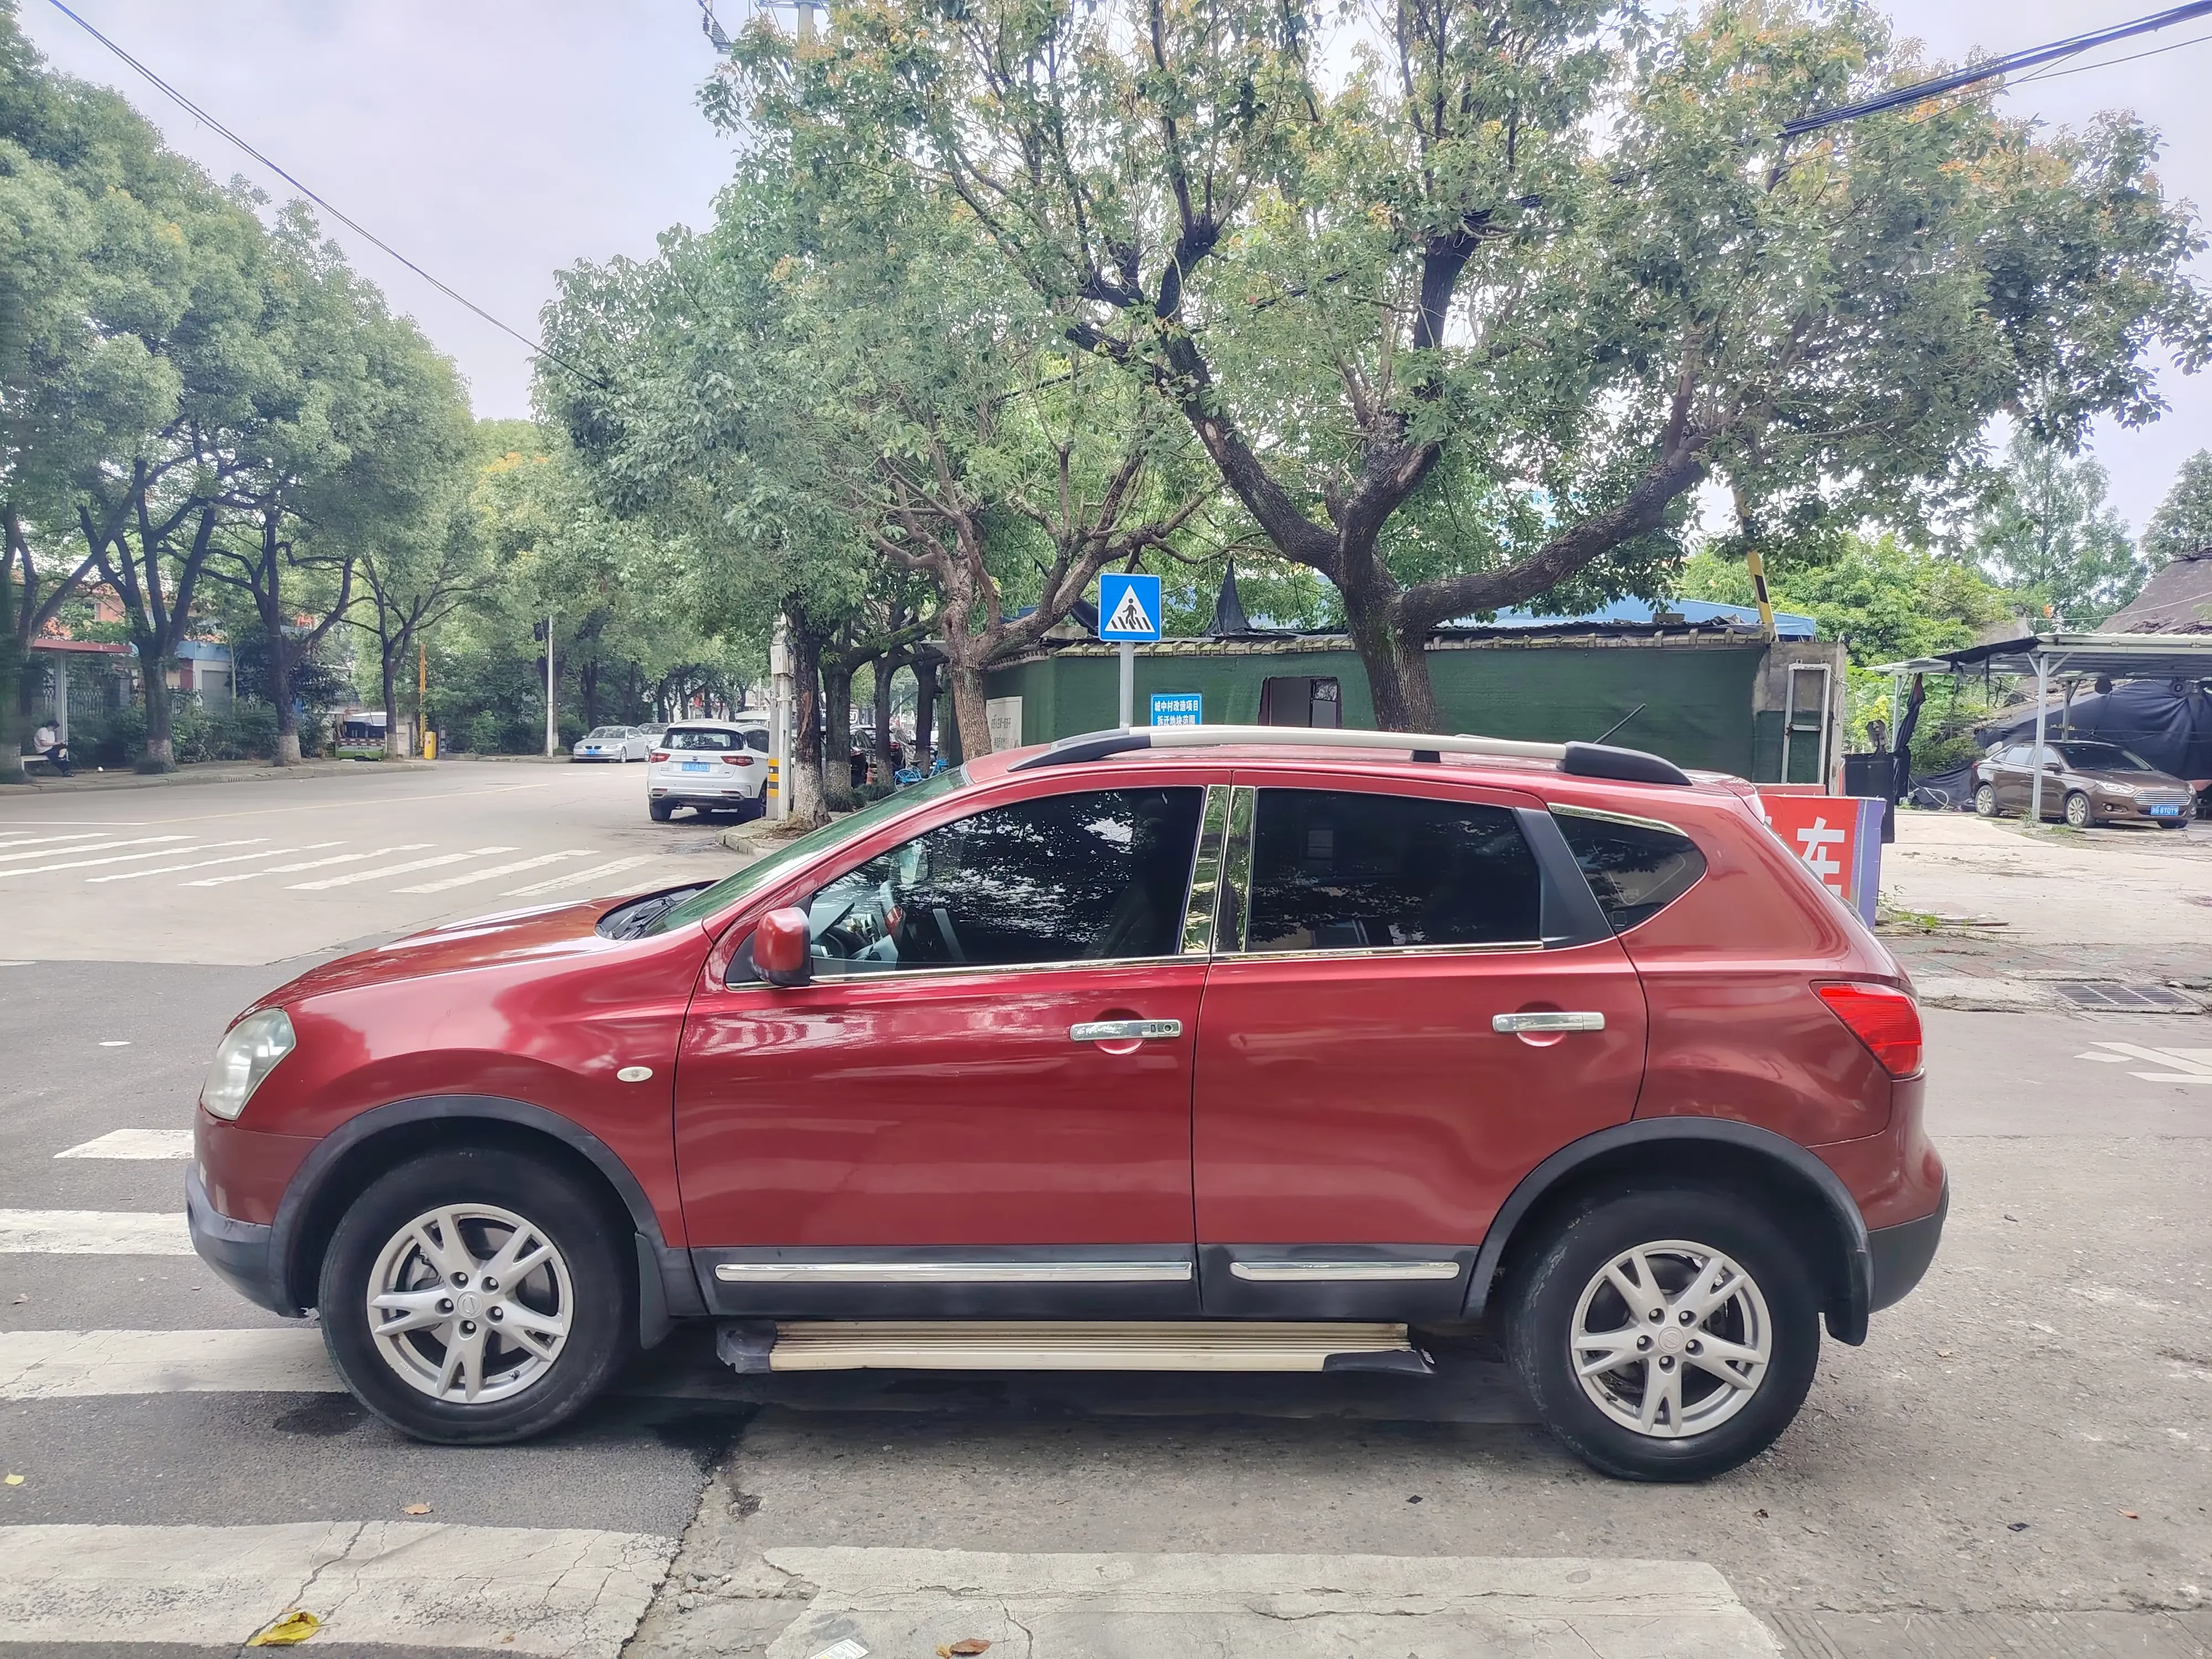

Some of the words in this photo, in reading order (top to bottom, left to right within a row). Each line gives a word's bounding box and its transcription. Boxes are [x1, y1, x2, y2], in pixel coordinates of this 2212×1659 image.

[1154, 700, 1198, 712] 城中村改造项目
[1157, 714, 1196, 726] 拆迁地块范围
